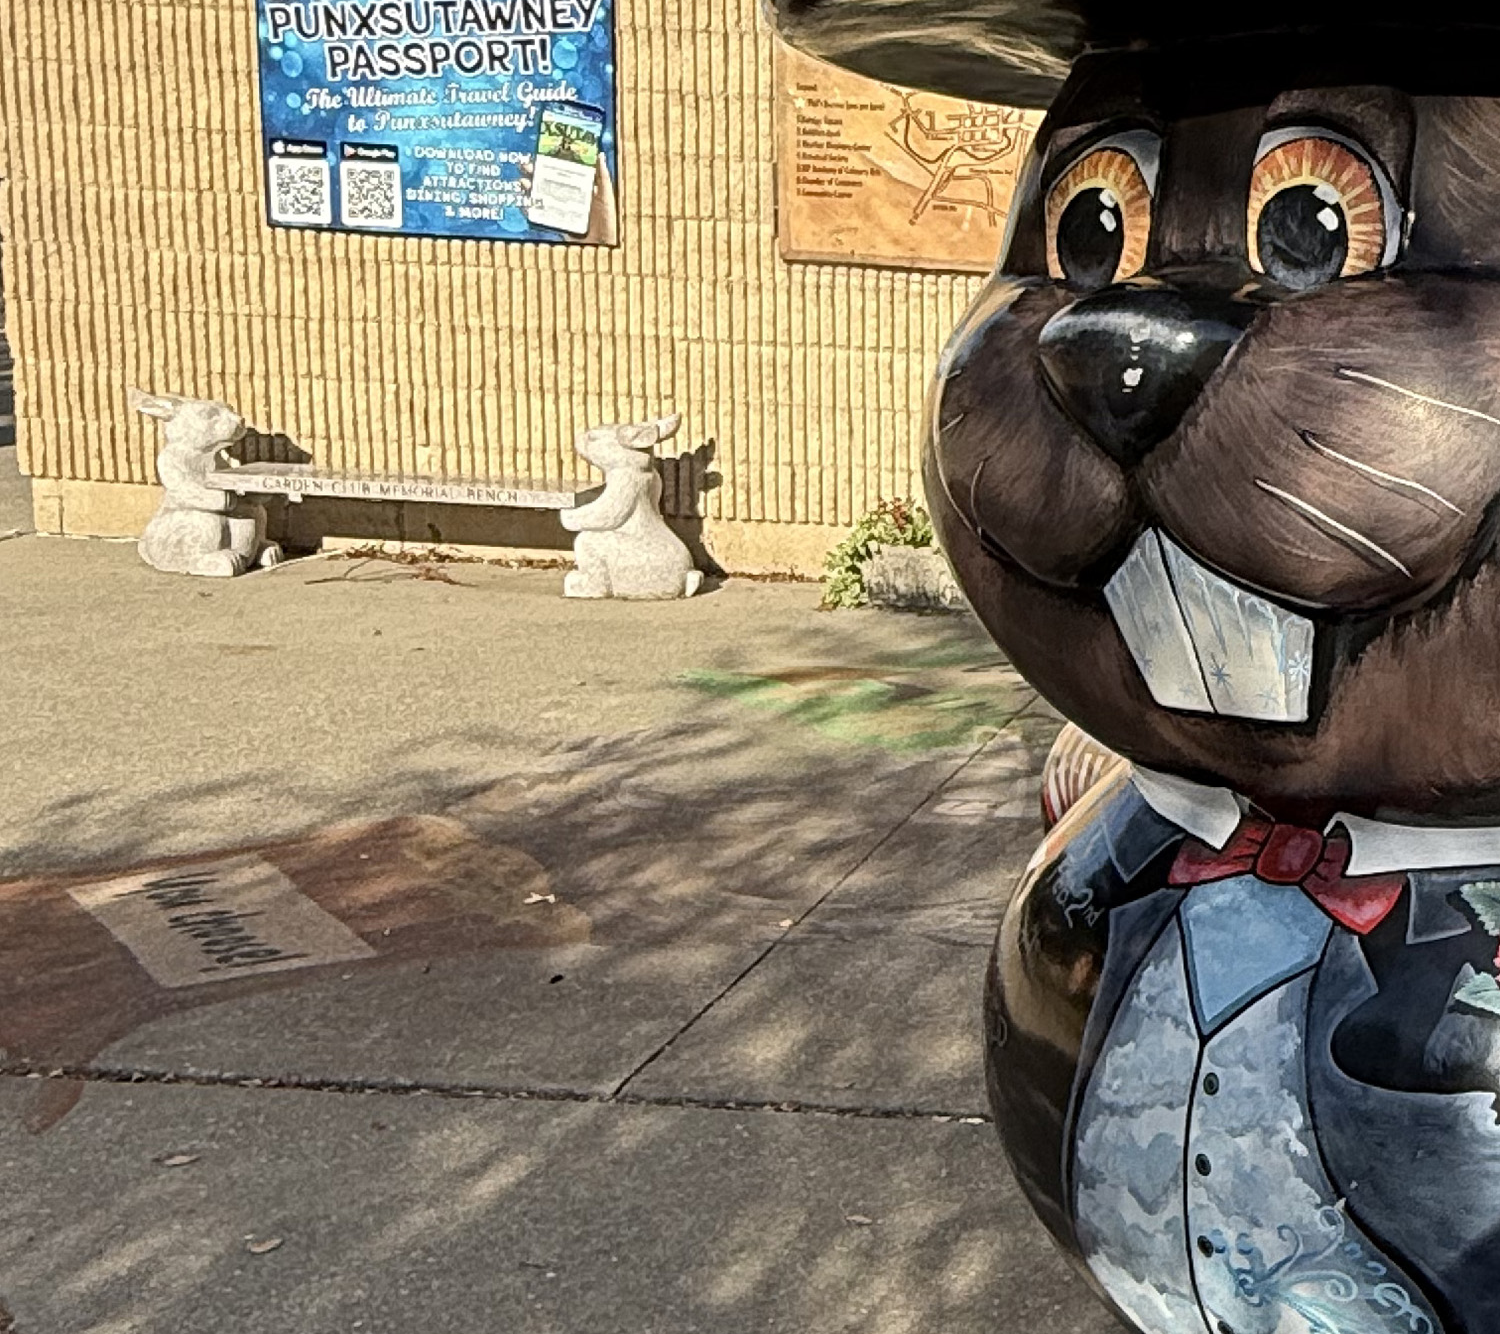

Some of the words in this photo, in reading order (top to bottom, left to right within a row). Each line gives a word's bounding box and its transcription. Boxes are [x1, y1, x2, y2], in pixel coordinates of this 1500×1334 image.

[326, 37, 552, 81] PASSPORT!
[306, 88, 343, 110] The
[345, 86, 438, 108] Ultimate
[445, 82, 511, 104] Travel
[516, 80, 579, 107] Guide
[347, 114, 369, 133] to
[374, 108, 536, 133] Punxsutawney!
[414, 146, 495, 163] DOWNLOAD
[499, 152, 532, 165] NOW
[446, 161, 466, 174] TO
[468, 163, 501, 177] FIND
[405, 188, 466, 205] DINING,
[469, 191, 545, 210] SHOPPING
[444, 205, 456, 217] &
[459, 206, 505, 221] MORE!
[262, 477, 324, 493] GARDEN
[331, 481, 371, 495] CLUB
[379, 484, 457, 499] MEMORIAL
[466, 488, 519, 503] BENCH
